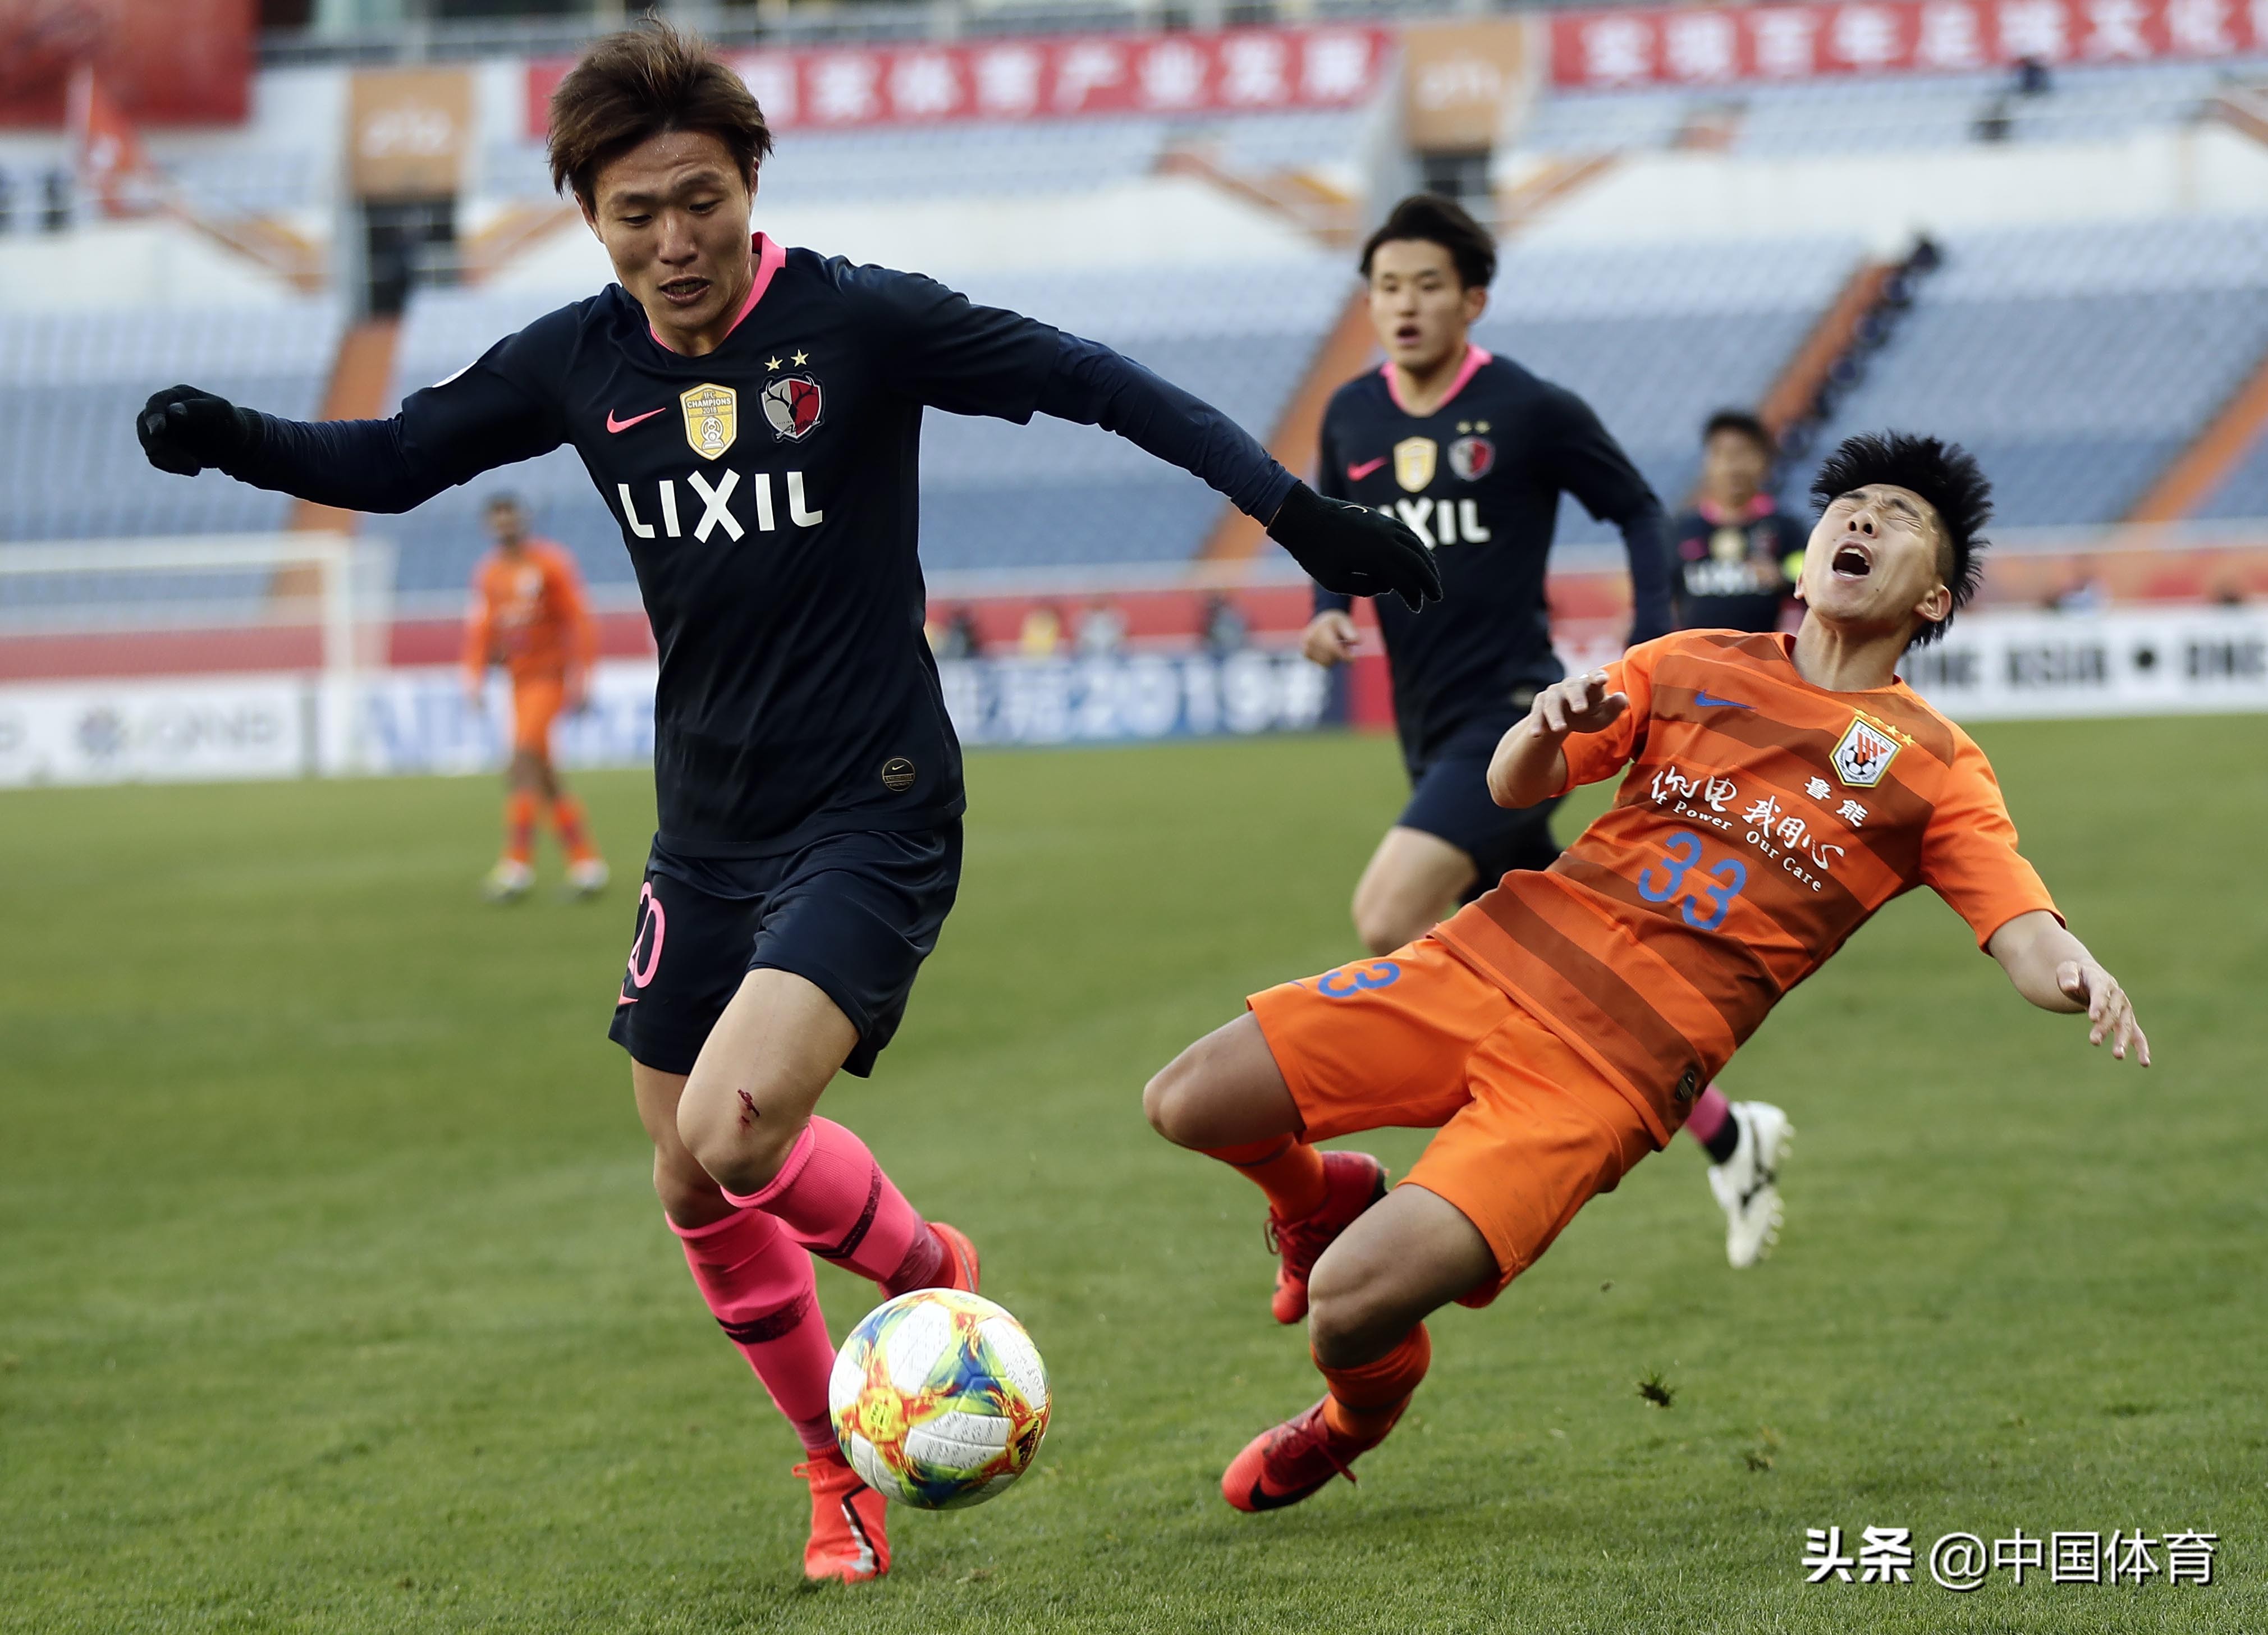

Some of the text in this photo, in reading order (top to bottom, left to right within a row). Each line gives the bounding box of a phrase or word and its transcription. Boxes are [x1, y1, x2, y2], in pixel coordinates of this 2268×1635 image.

[687, 397, 731, 408] CHAMPIONS
[617, 468, 822, 543] LIXIL
[1376, 496, 1491, 550] XIL
[1804, 776, 1868, 827] 鲁能
[1673, 800, 1822, 892] Power Our Care
[1638, 831, 1746, 931] 33
